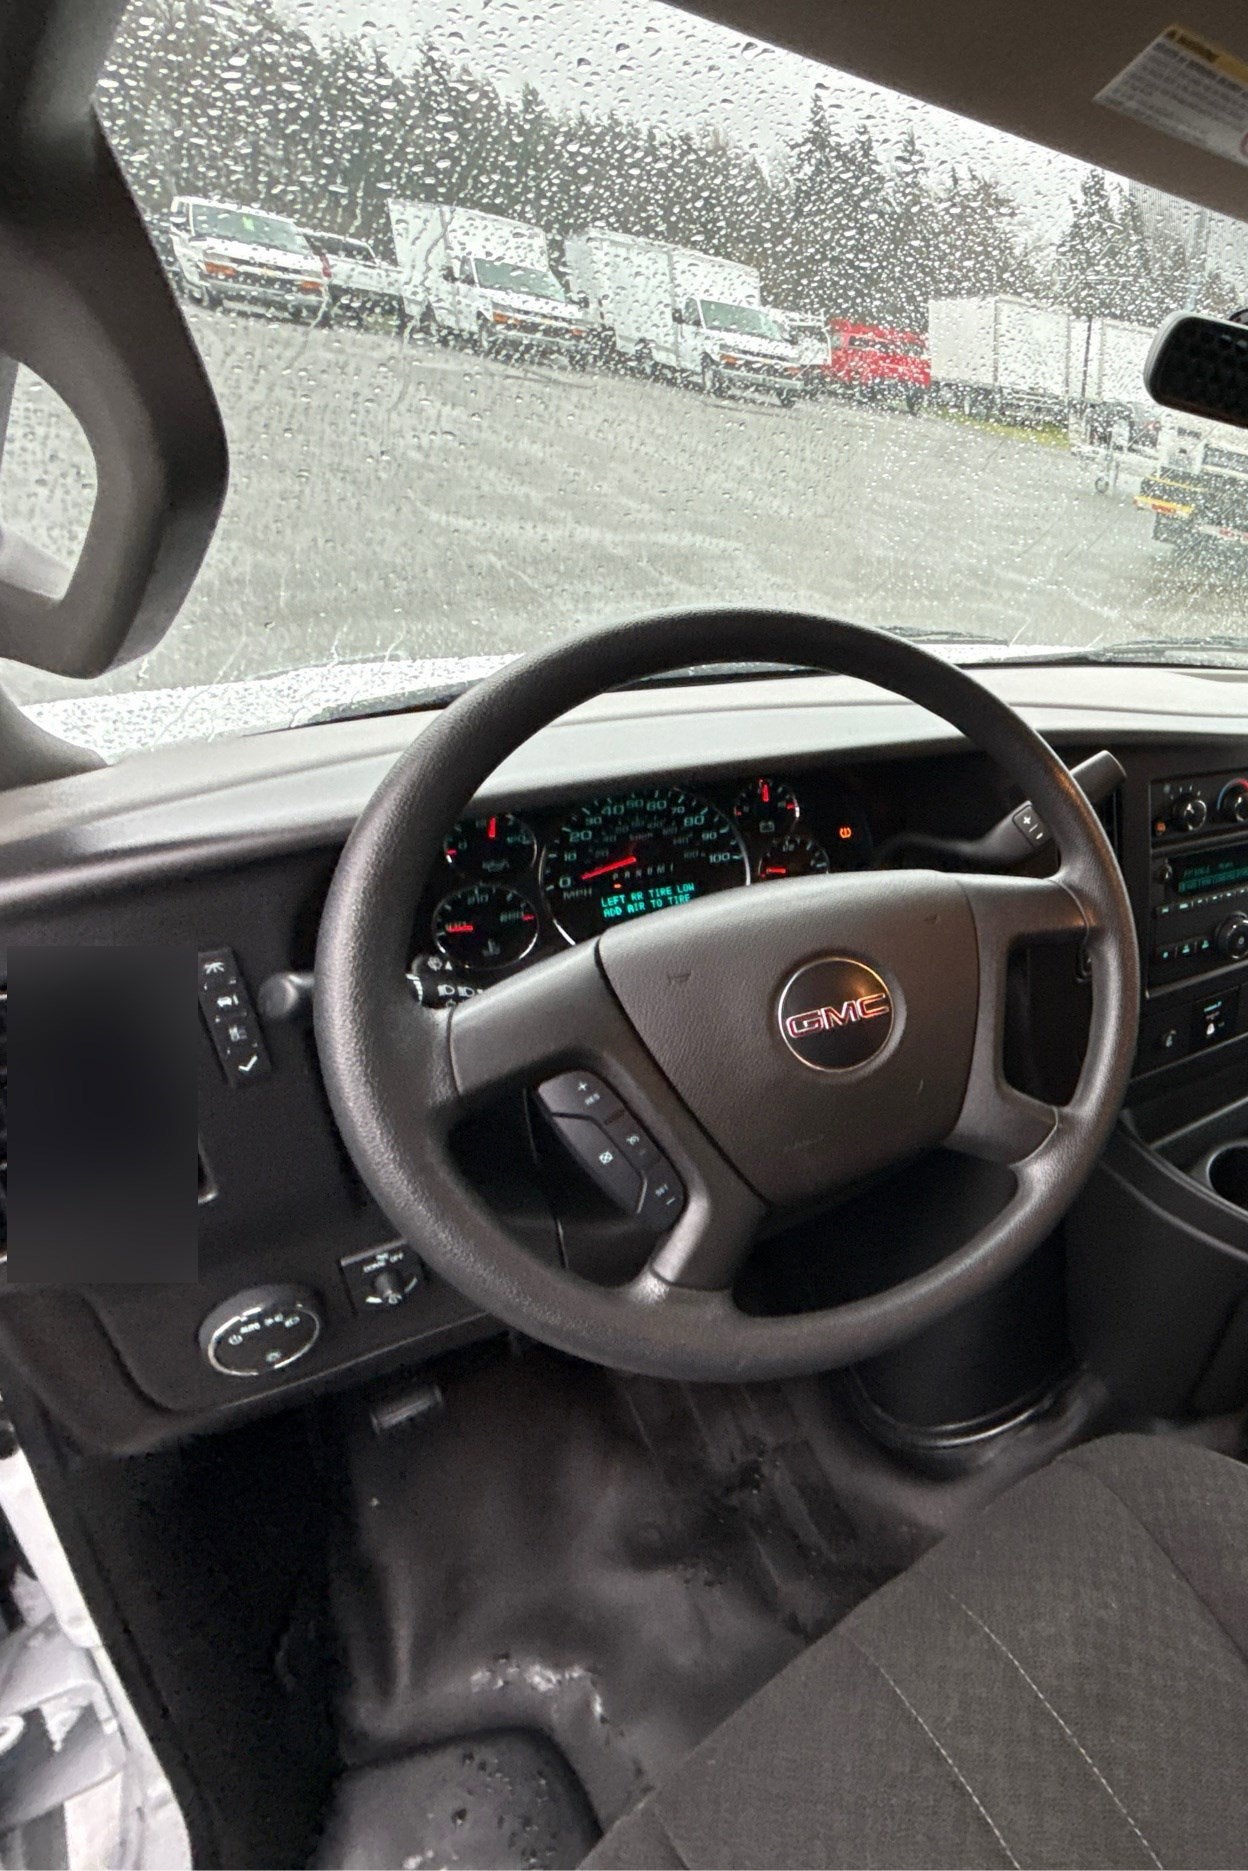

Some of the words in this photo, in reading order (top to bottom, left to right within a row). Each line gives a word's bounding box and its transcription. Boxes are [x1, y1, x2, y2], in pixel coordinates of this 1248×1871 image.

[601, 803, 625, 816] 40
[670, 805, 686, 815] 70
[683, 815, 705, 827] 80
[569, 829, 593, 843] 20
[701, 831, 718, 841] 90
[563, 851, 578, 863] 10
[709, 852, 731, 864] 100
[559, 876, 572, 889] 0
[563, 886, 593, 901] MPH
[600, 894, 626, 908] LEFT
[630, 890, 644, 901] RR
[648, 886, 673, 898] TIRE
[676, 881, 695, 894] LOW
[603, 906, 623, 918] ADD
[627, 901, 646, 914] AIR
[650, 898, 663, 909] TO
[667, 893, 691, 905] TIRE
[785, 993, 890, 1038] GMC
[240, 1322, 261, 1334] AUTO
